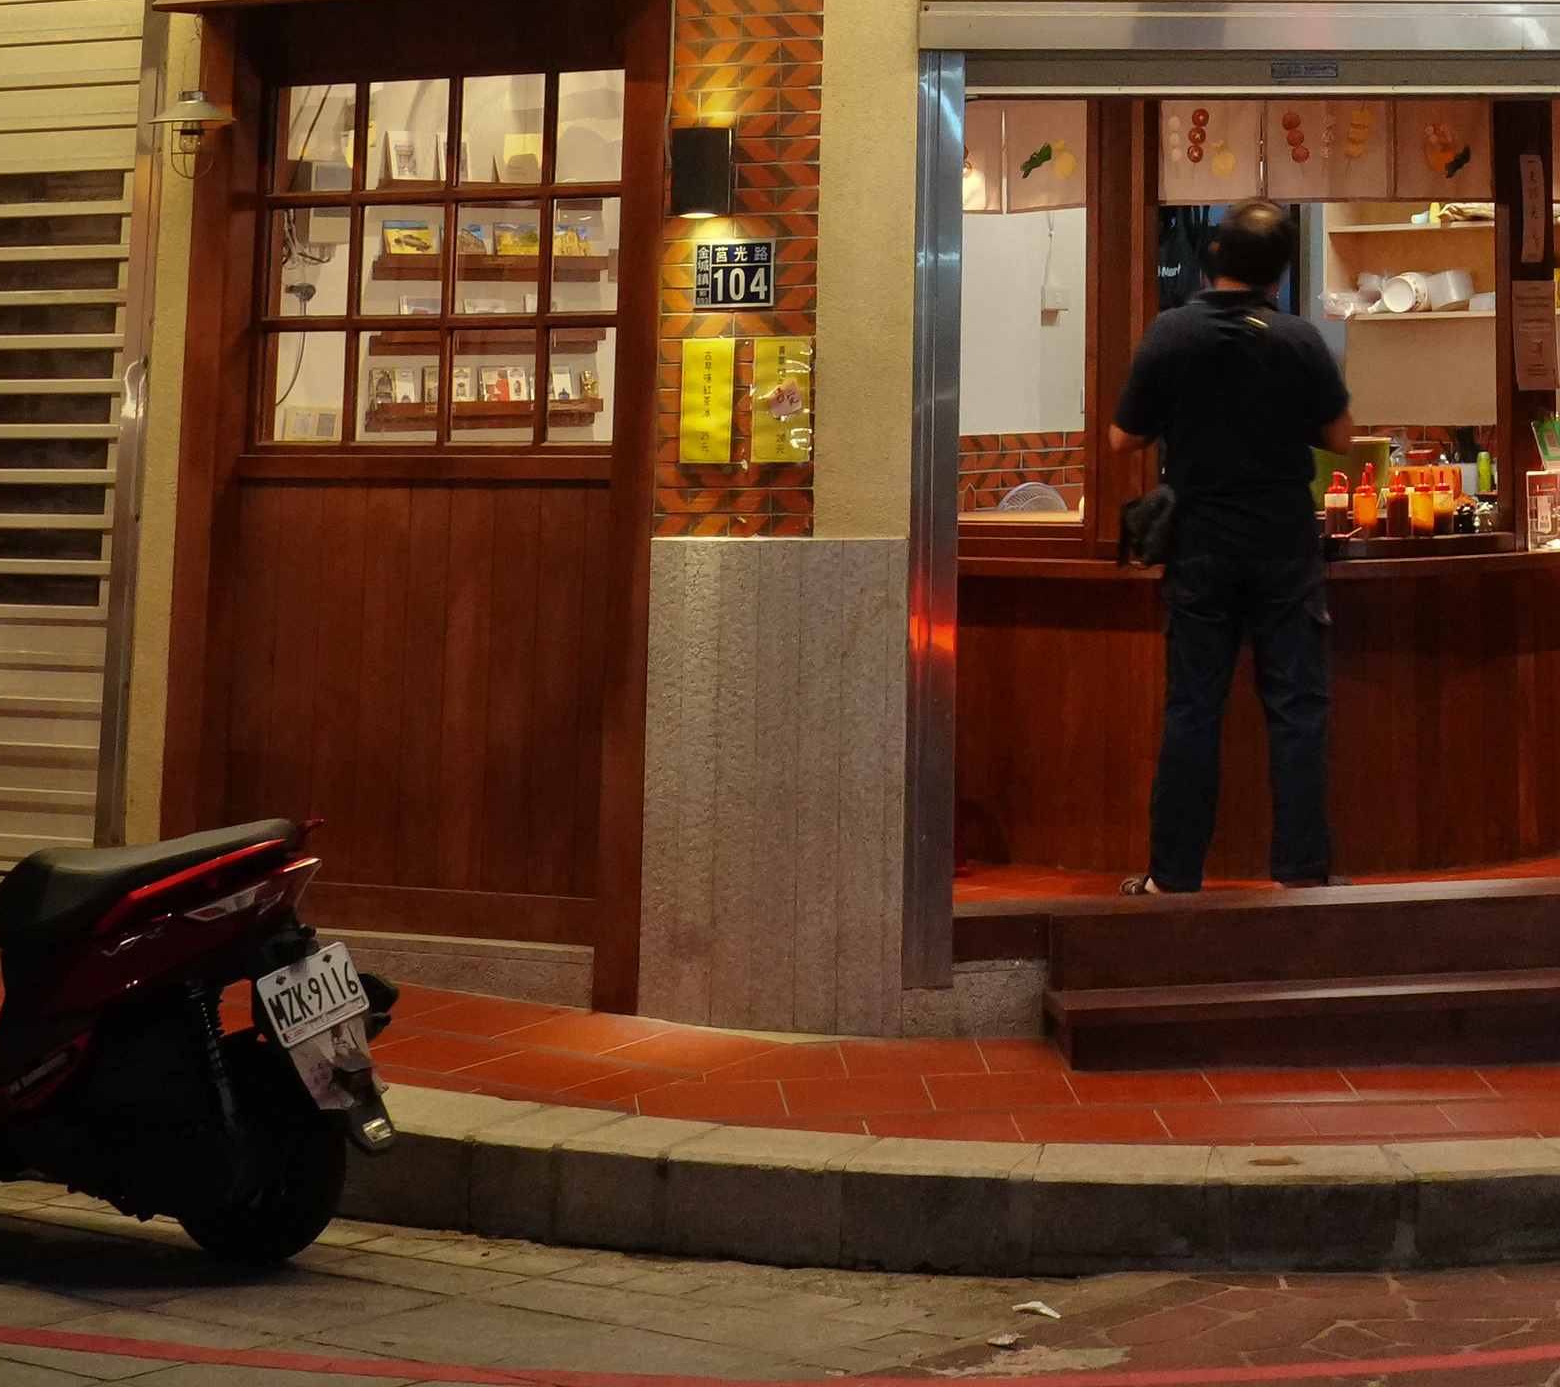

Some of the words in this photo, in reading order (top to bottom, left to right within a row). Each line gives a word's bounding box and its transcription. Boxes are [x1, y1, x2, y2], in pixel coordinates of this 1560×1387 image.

[697, 246, 710, 286] 金城鎮
[714, 245, 769, 263] 莒光路
[713, 267, 769, 302] 104
